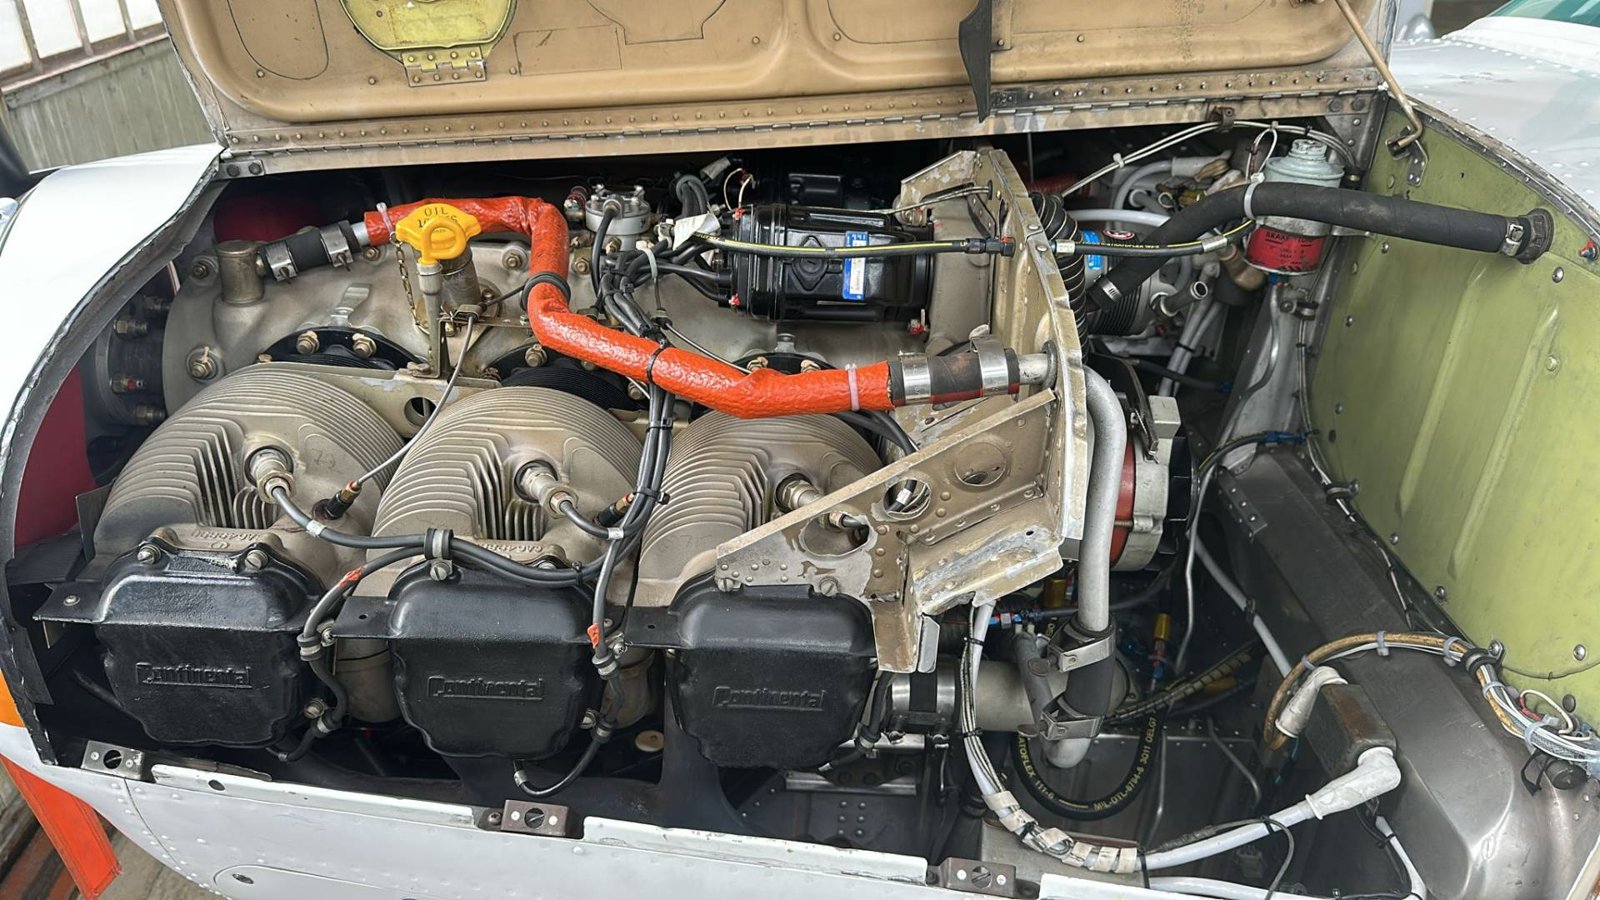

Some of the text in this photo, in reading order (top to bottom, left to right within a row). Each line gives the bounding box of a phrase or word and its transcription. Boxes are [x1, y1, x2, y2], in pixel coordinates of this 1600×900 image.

[424, 207, 448, 217] OIL
[136, 662, 252, 689] Continental
[427, 676, 542, 700] Continental
[712, 686, 826, 712] Continental
[1018, 735, 1036, 778] ATOFLEX
